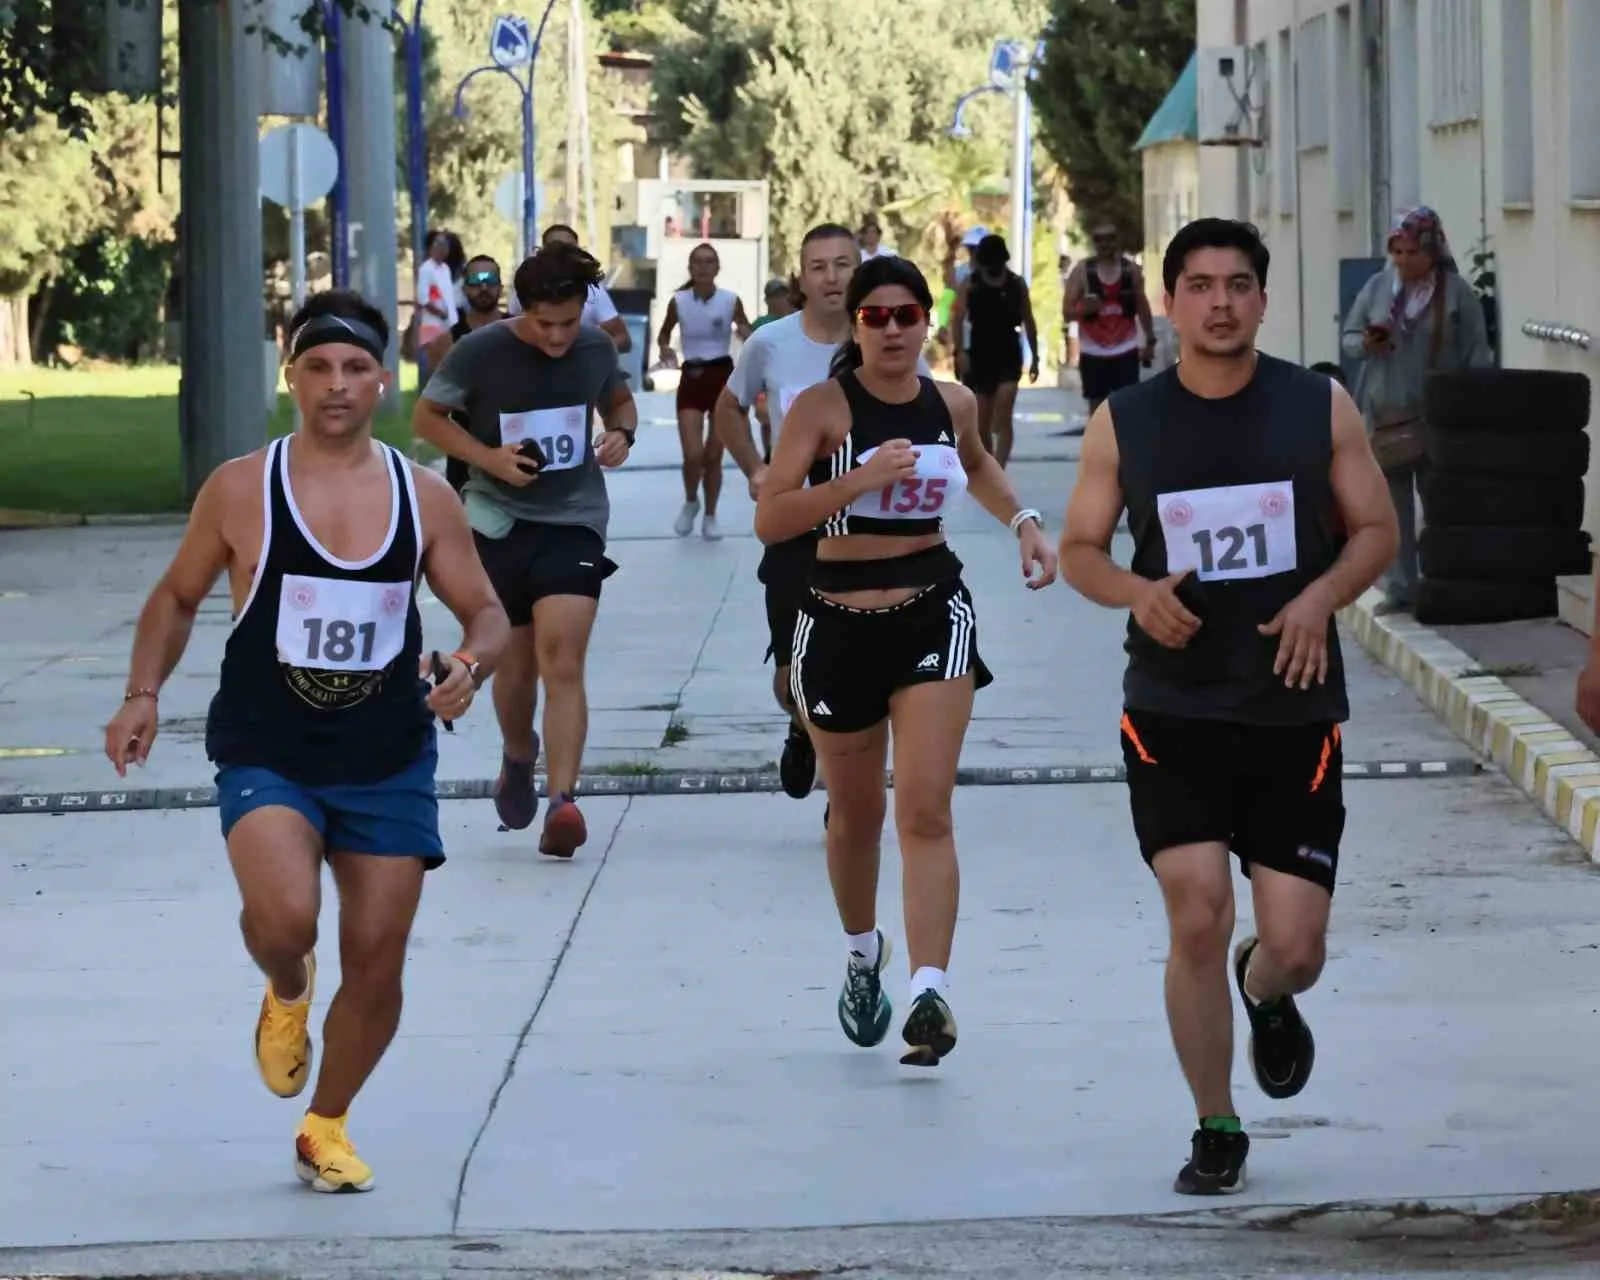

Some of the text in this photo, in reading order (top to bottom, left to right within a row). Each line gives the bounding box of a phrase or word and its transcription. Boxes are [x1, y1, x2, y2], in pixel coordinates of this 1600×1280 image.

[520, 434, 574, 465] 19
[880, 478, 948, 513] 135
[1191, 523, 1269, 573] 121
[303, 618, 377, 663] 181
